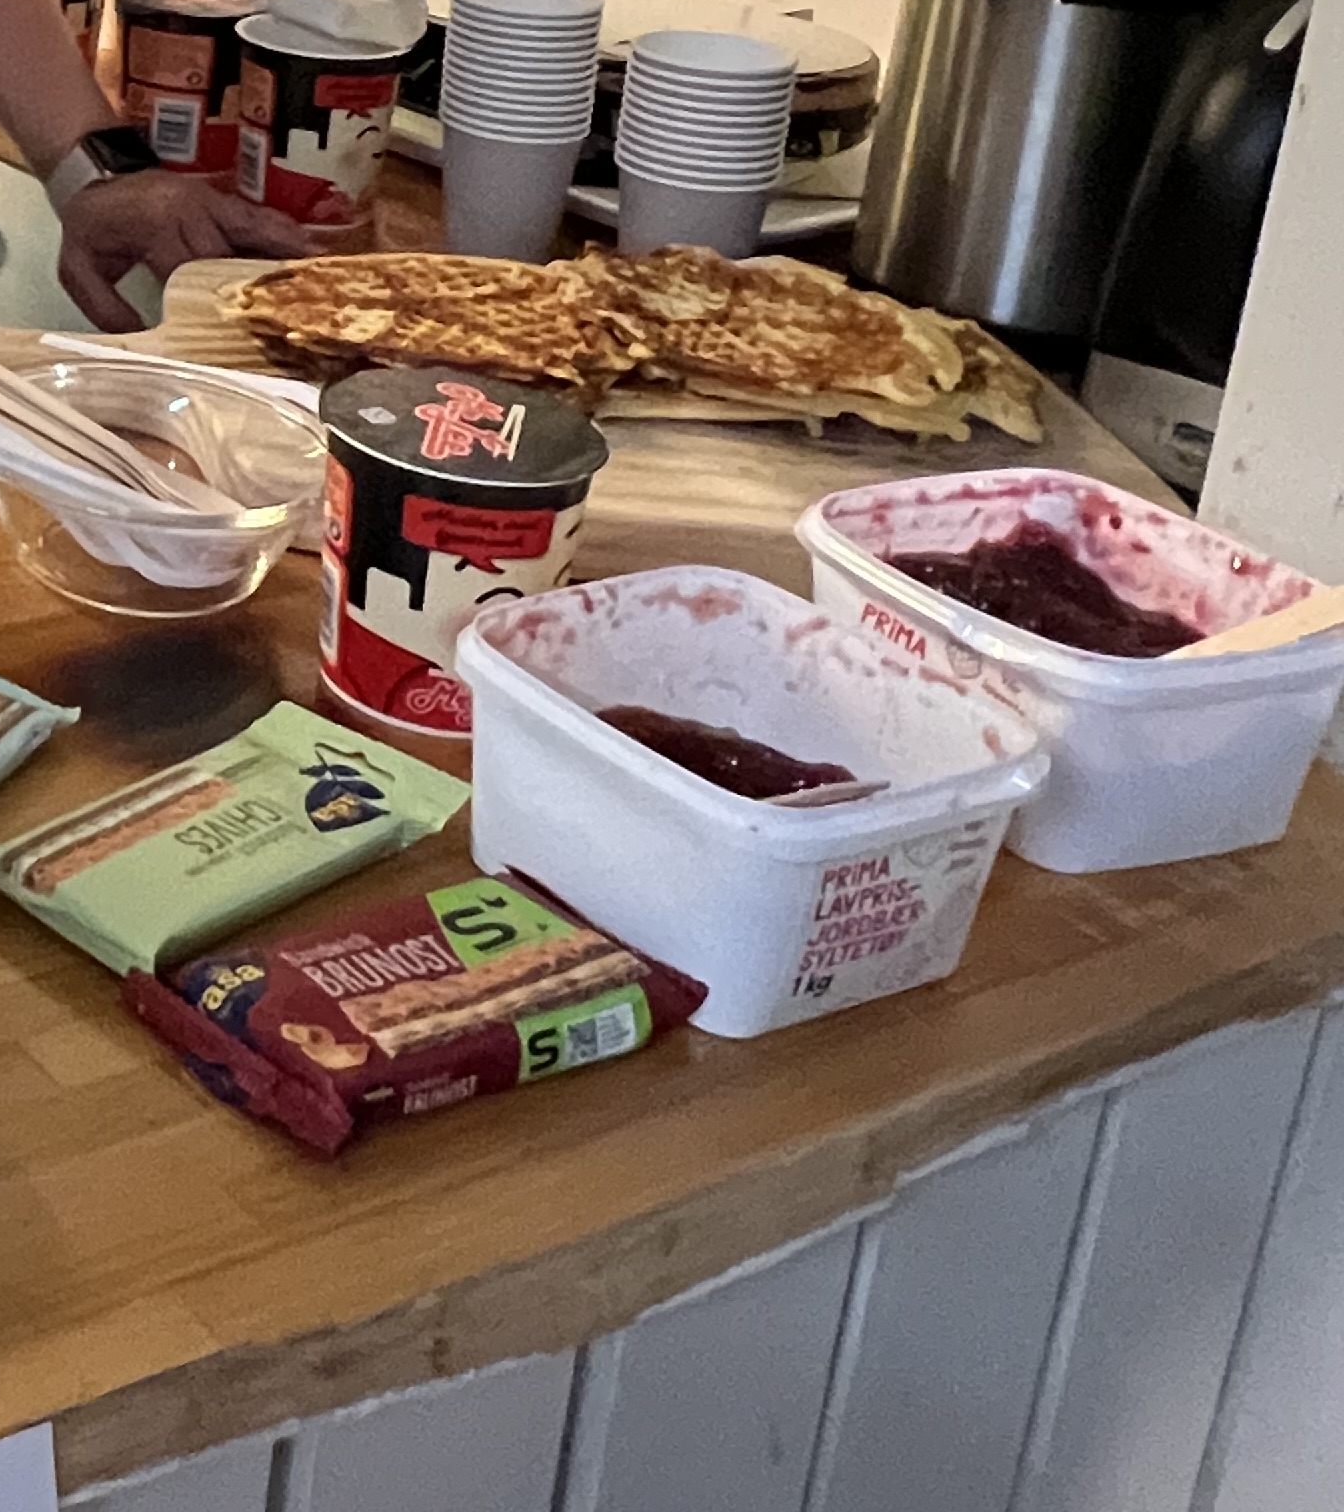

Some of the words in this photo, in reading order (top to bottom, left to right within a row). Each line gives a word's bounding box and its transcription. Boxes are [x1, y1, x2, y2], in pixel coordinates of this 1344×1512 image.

[861, 601, 927, 661] PRIMA
[173, 799, 283, 856] CHIVES
[821, 854, 891, 895] PRIMA
[301, 934, 461, 998] BRUNOST
[792, 975, 803, 997] 1
[804, 972, 835, 998] kg
